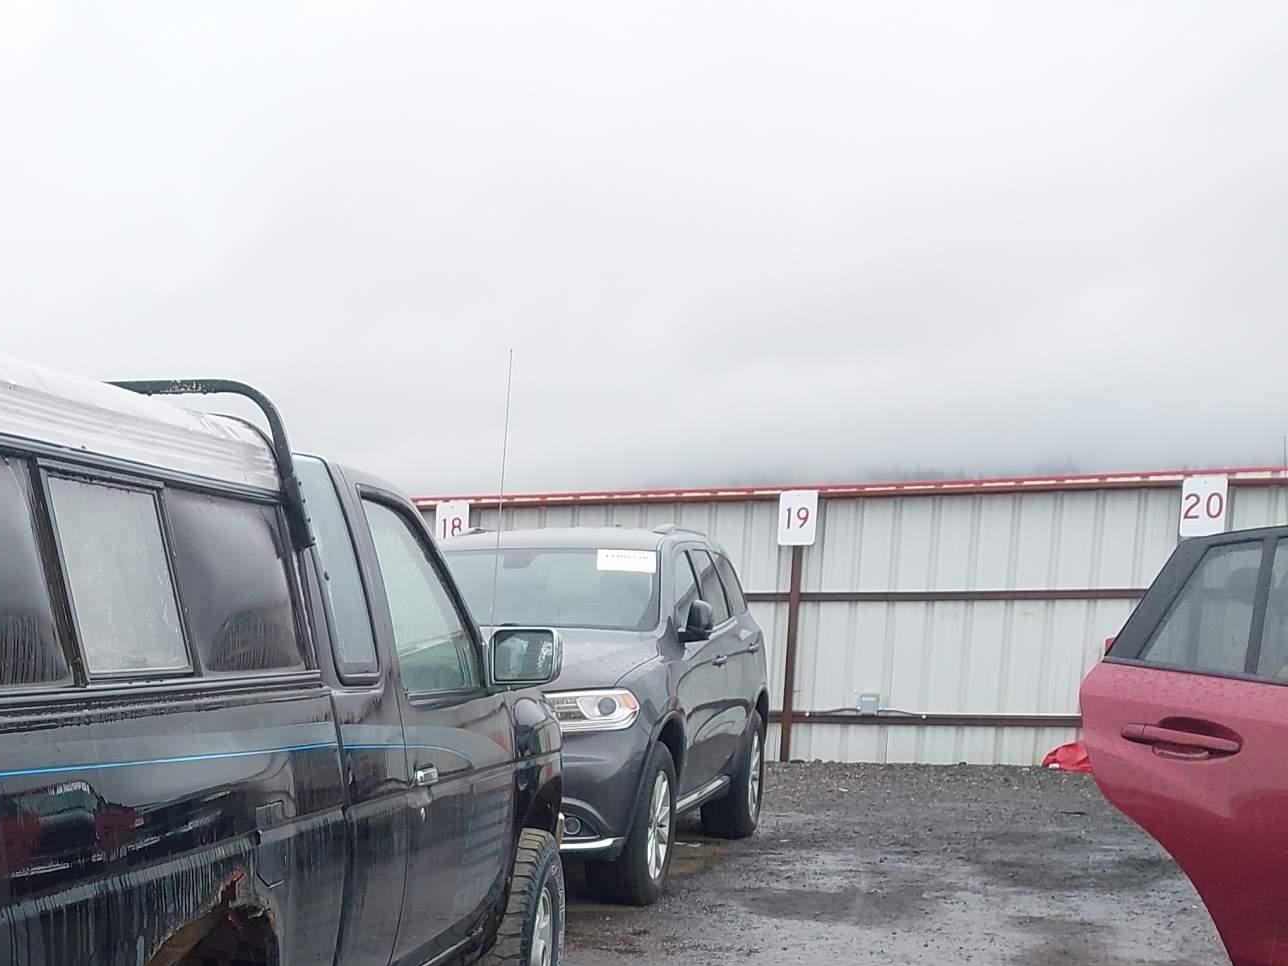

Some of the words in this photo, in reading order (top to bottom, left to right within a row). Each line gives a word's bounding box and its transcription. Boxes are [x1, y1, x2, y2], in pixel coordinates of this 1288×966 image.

[786, 506, 810, 530] 19
[1183, 492, 1224, 520] 20
[442, 517, 462, 539] 18
